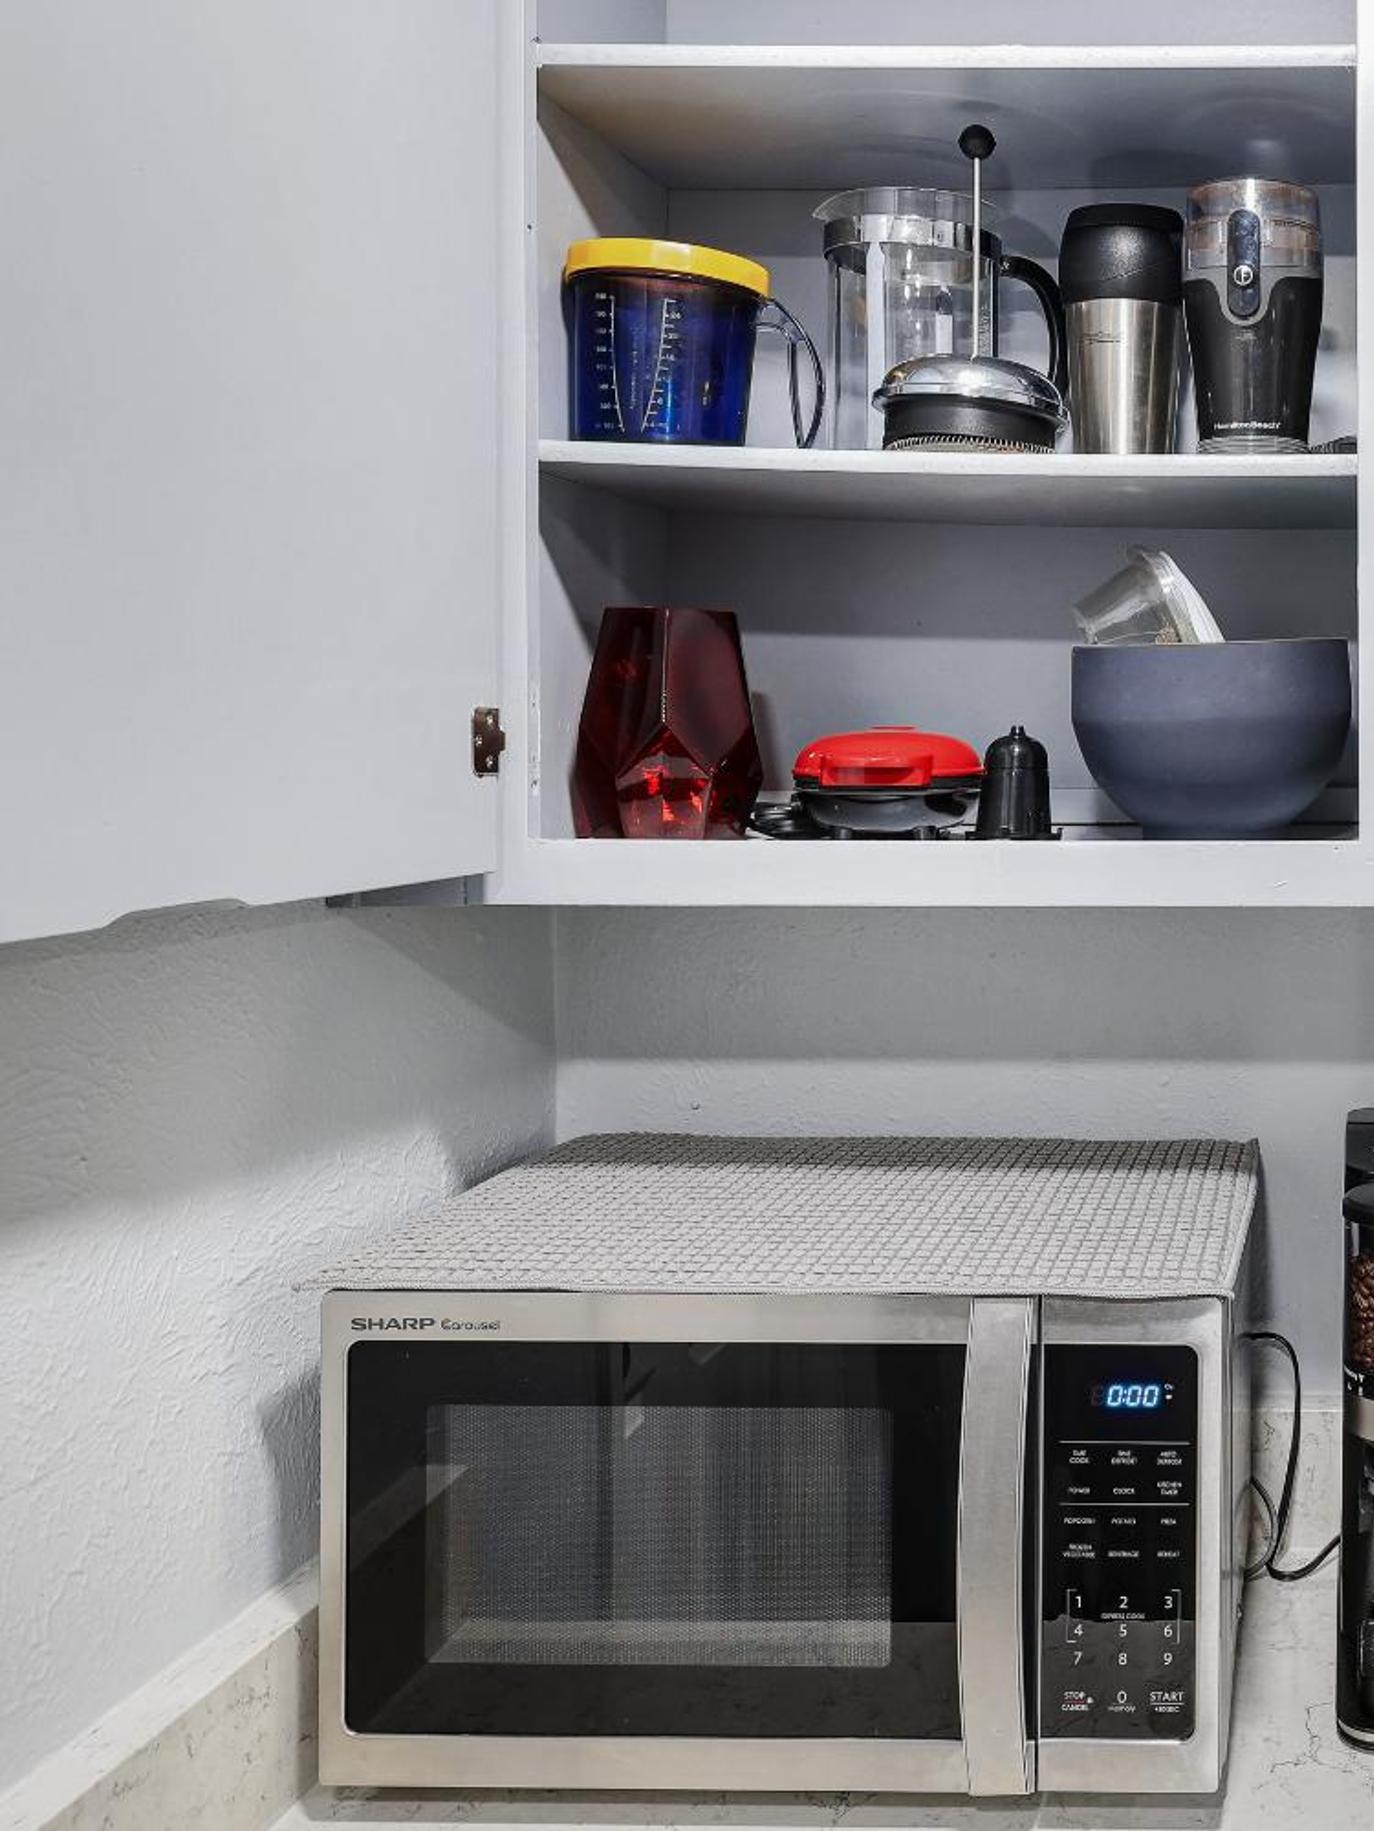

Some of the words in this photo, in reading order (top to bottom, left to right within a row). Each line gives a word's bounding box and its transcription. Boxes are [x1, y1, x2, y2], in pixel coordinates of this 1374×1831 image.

[351, 1318, 435, 1330] SHARP
[441, 1318, 501, 1330] Carousel
[1107, 1385, 1159, 1406] 0:00
[1076, 1596, 1081, 1608] 1
[1119, 1596, 1128, 1608] 2
[1164, 1596, 1173, 1608] 3
[1074, 1624, 1083, 1636] 4
[1119, 1624, 1127, 1637] 5
[1164, 1624, 1173, 1637] 6
[1074, 1652, 1082, 1665] 7
[1118, 1653, 1127, 1665] 8
[1163, 1653, 1173, 1665] 9
[1117, 1691, 1127, 1703] 0
[1150, 1691, 1184, 1702] START
